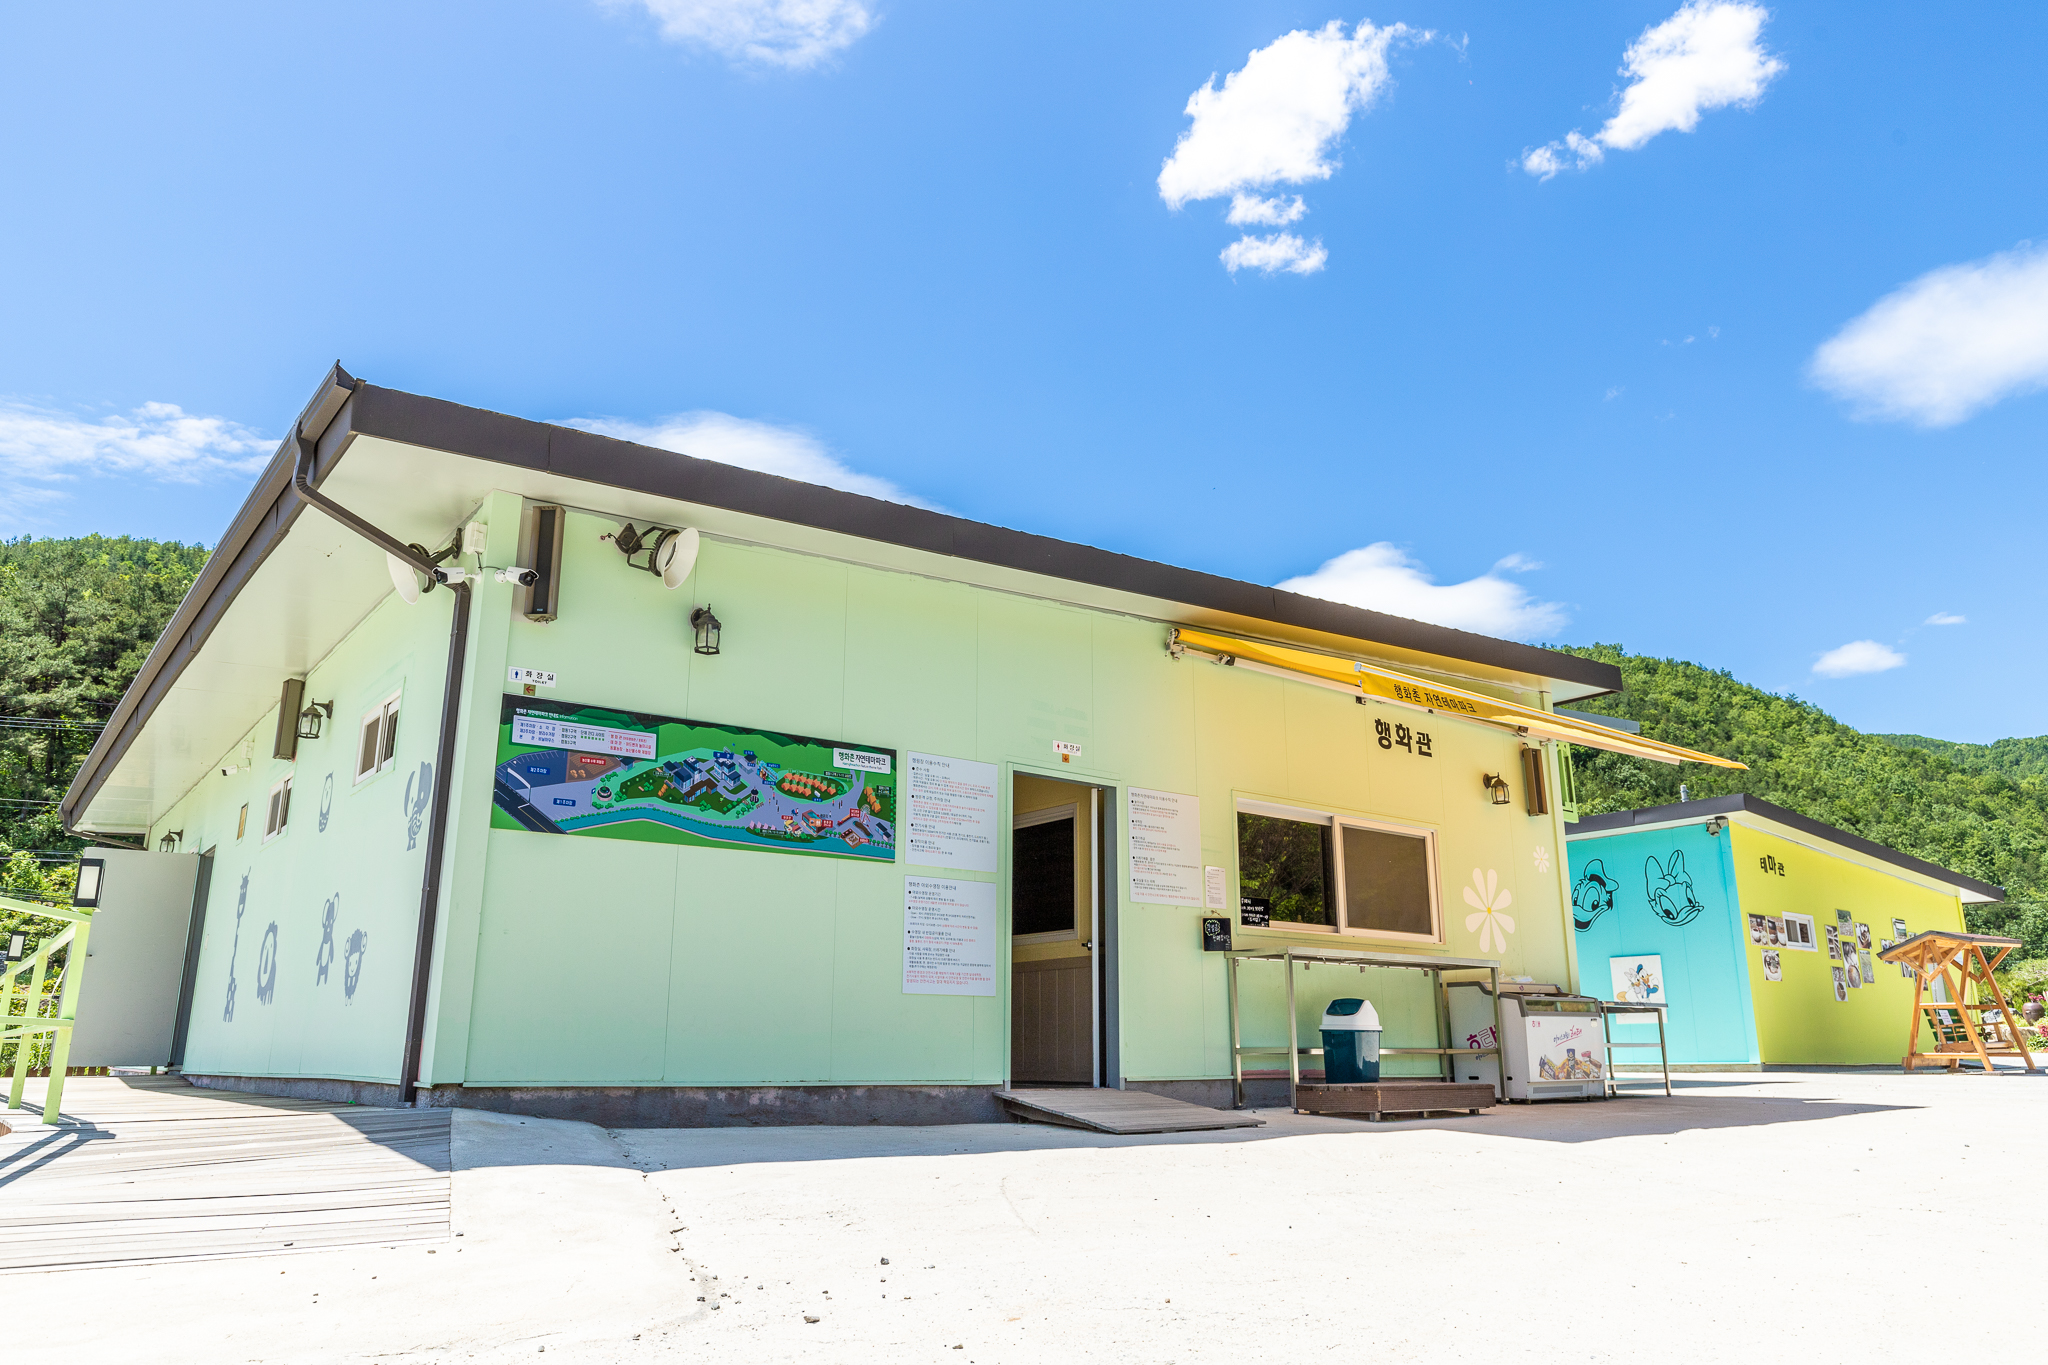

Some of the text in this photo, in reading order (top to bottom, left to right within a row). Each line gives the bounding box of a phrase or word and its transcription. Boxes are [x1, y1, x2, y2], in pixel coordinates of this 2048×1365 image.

[525, 670, 554, 681] 화장실
[1394, 684, 1477, 713] 행화촌 자연테마파크
[1375, 718, 1432, 758] 행화관
[856, 754, 886, 766] 자연테마파크
[1760, 854, 1785, 877] 테마관
